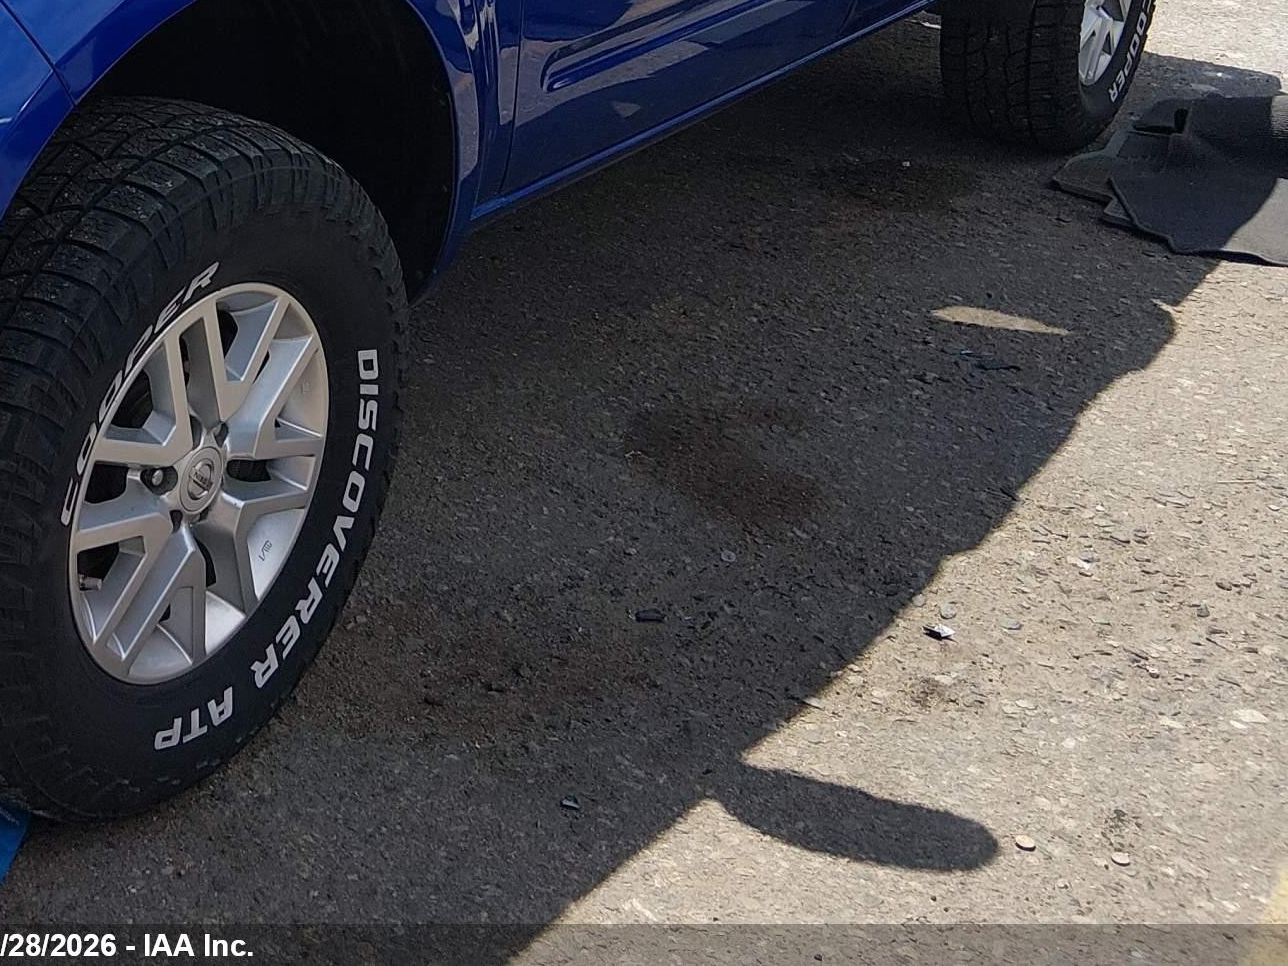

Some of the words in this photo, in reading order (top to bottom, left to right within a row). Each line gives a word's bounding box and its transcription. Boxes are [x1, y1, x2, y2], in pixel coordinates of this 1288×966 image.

[61, 261, 220, 526] COOPER
[250, 348, 381, 689] DISCOVERER
[153, 686, 235, 752] ATP
